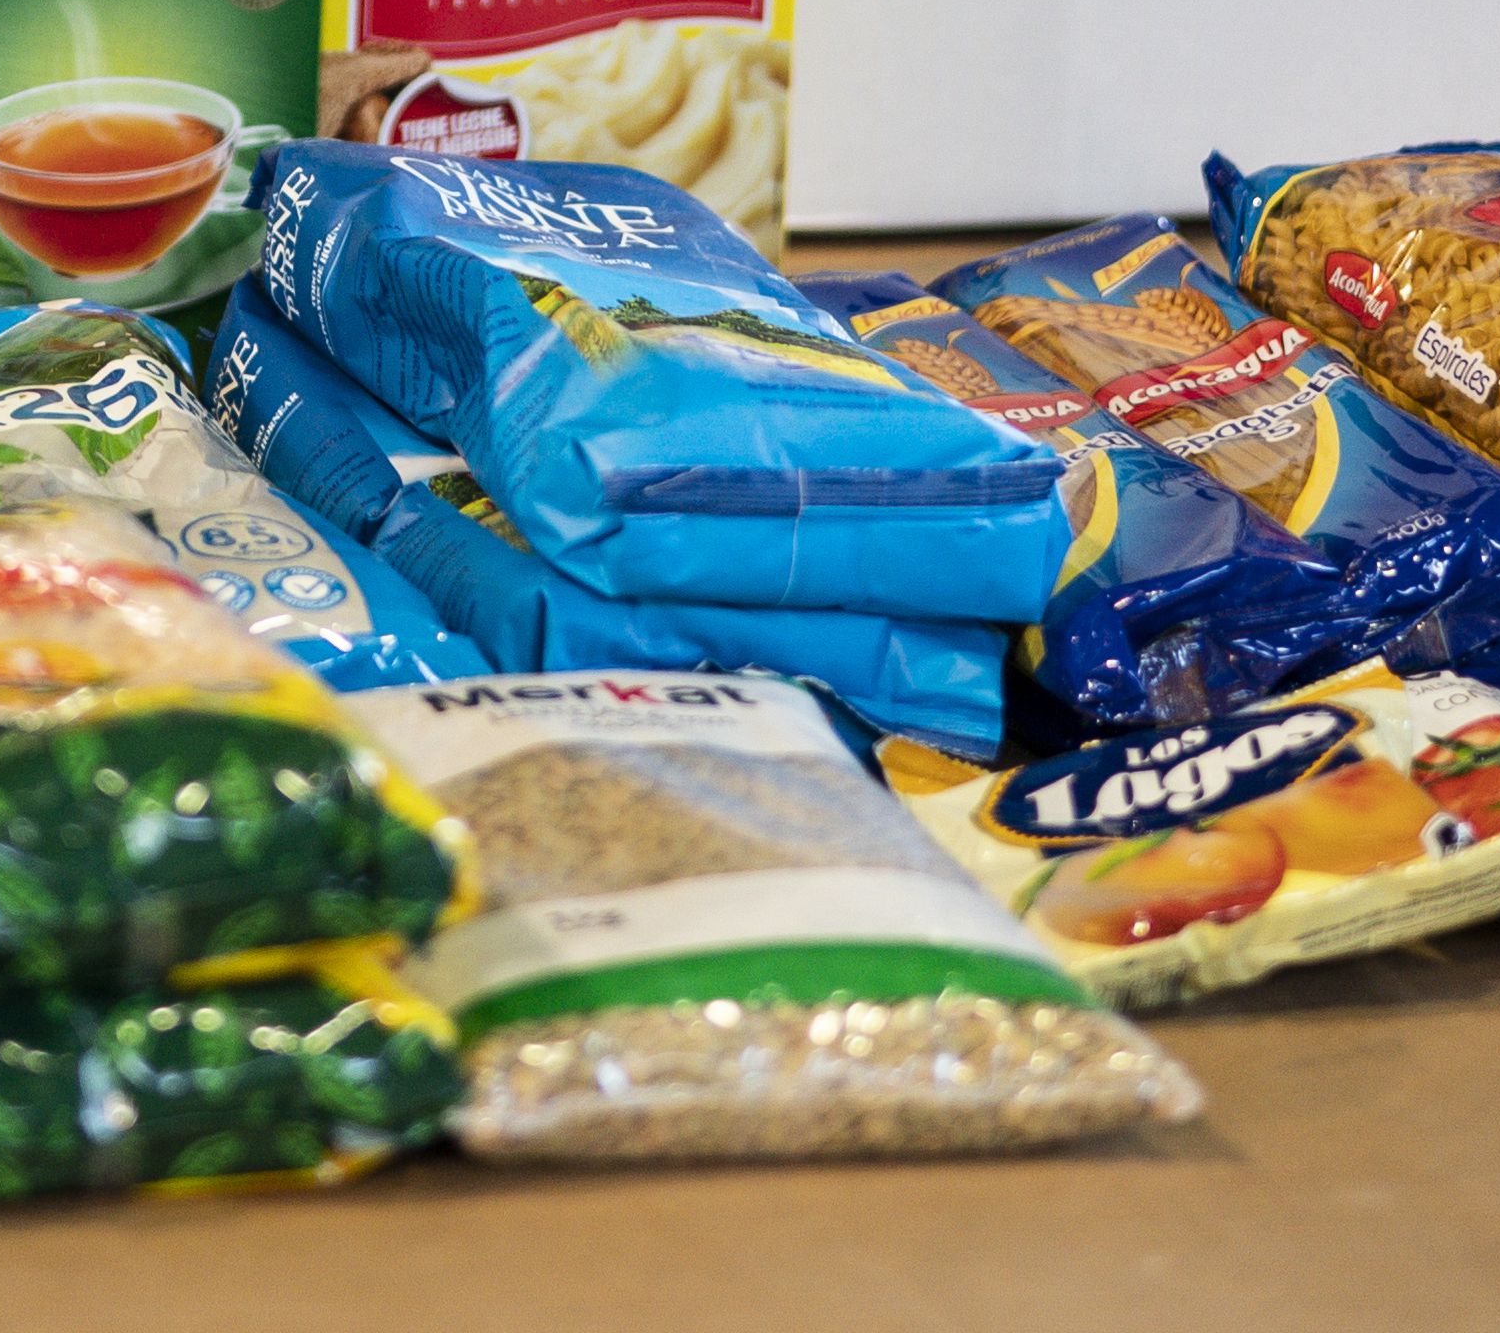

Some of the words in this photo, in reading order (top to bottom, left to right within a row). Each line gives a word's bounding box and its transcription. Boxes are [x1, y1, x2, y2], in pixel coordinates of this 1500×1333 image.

[389, 155, 675, 235] CISNE
[443, 158, 587, 203] HARINA
[269, 166, 316, 321] CISNE
[1418, 324, 1492, 397] Espirales
[420, 678, 758, 713] Merkat
[1024, 711, 1340, 829] Lagos
[1124, 725, 1213, 770] LOS
